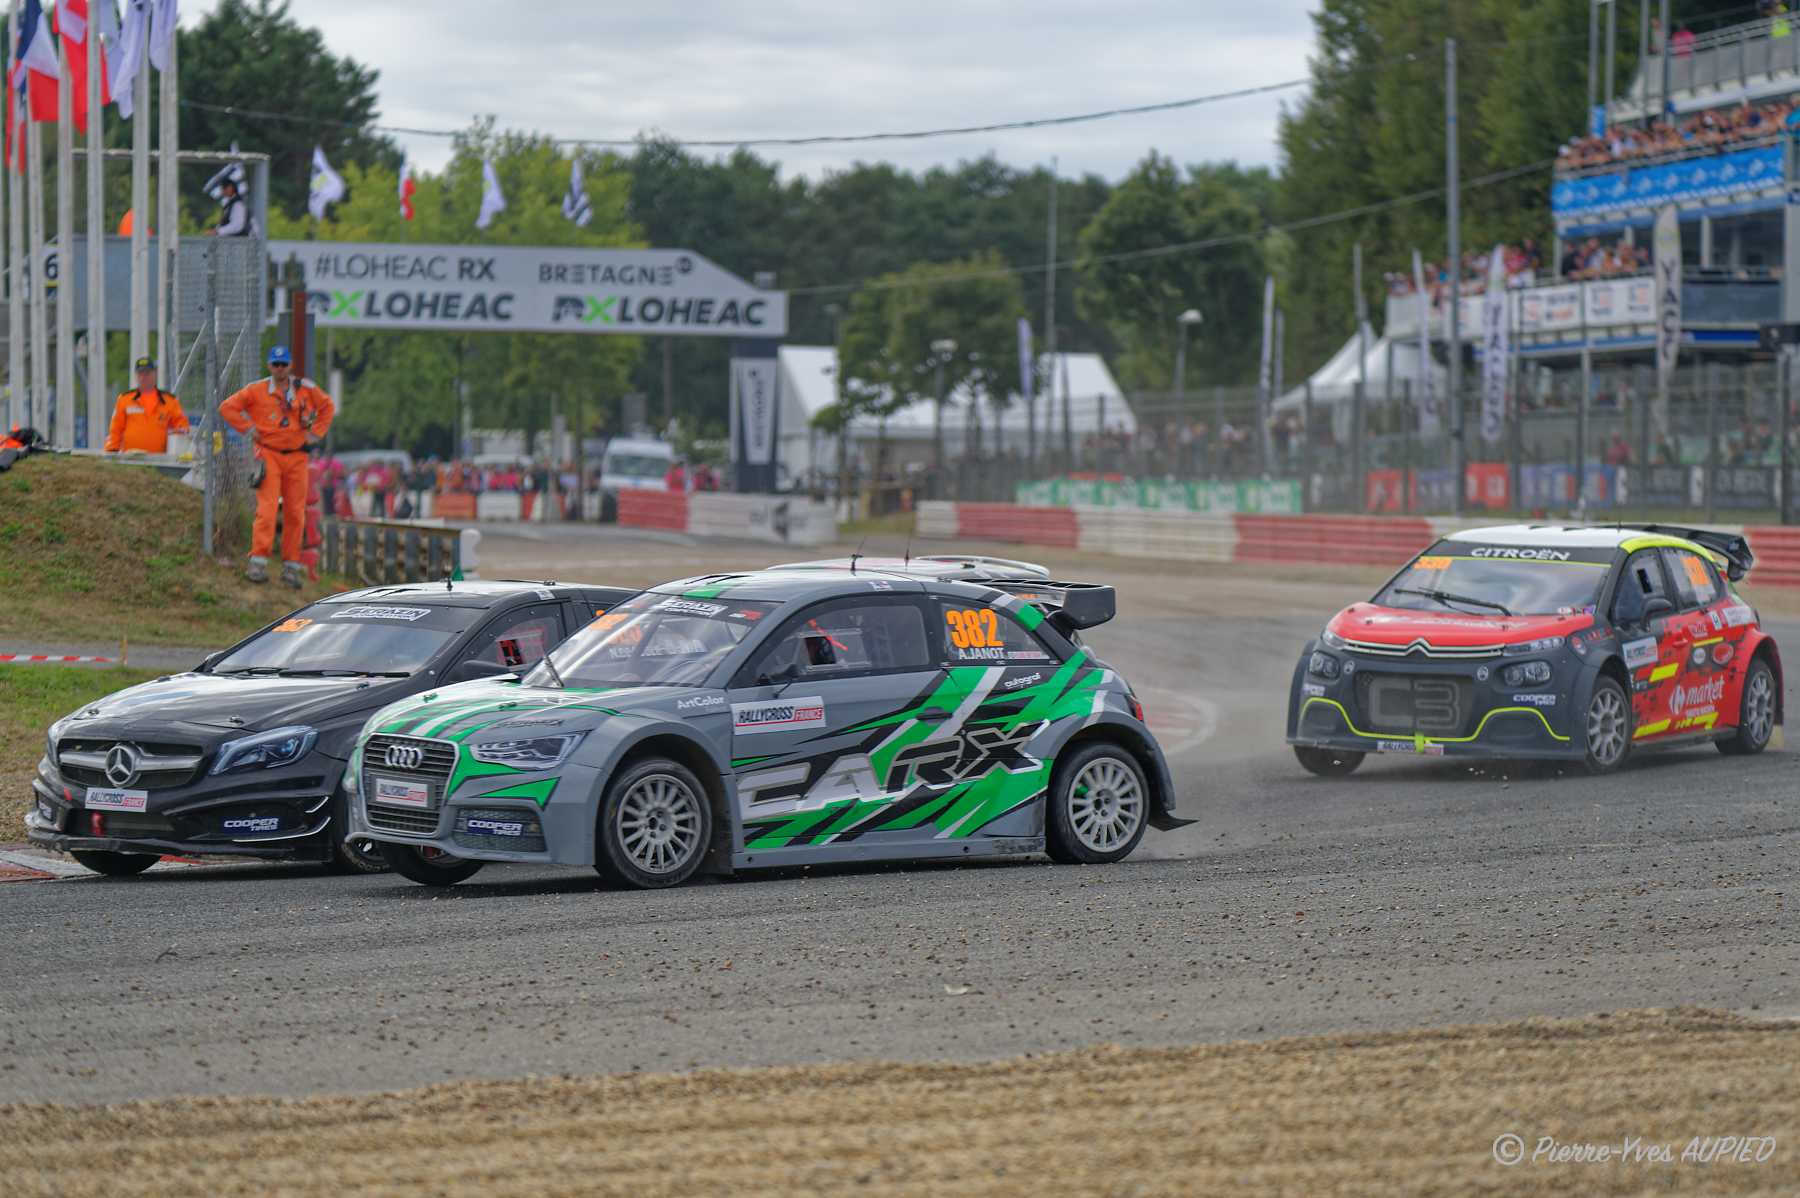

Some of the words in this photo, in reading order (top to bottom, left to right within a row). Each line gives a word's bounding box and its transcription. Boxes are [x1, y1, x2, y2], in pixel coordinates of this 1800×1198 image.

[314, 252, 447, 280] #LOHEAC
[457, 257, 496, 281] RX
[538, 262, 674, 286] BRETAGNE
[1471, 547, 1570, 561] CITROËN
[945, 608, 1005, 649] 382
[1686, 674, 1725, 704] market
[676, 695, 725, 710] ArtColor
[1368, 676, 1460, 730] C3
[737, 706, 795, 724] RALLYCROSS
[223, 818, 279, 828] COOPER
[250, 824, 278, 832] TIRES
[468, 820, 522, 831] COOPER
